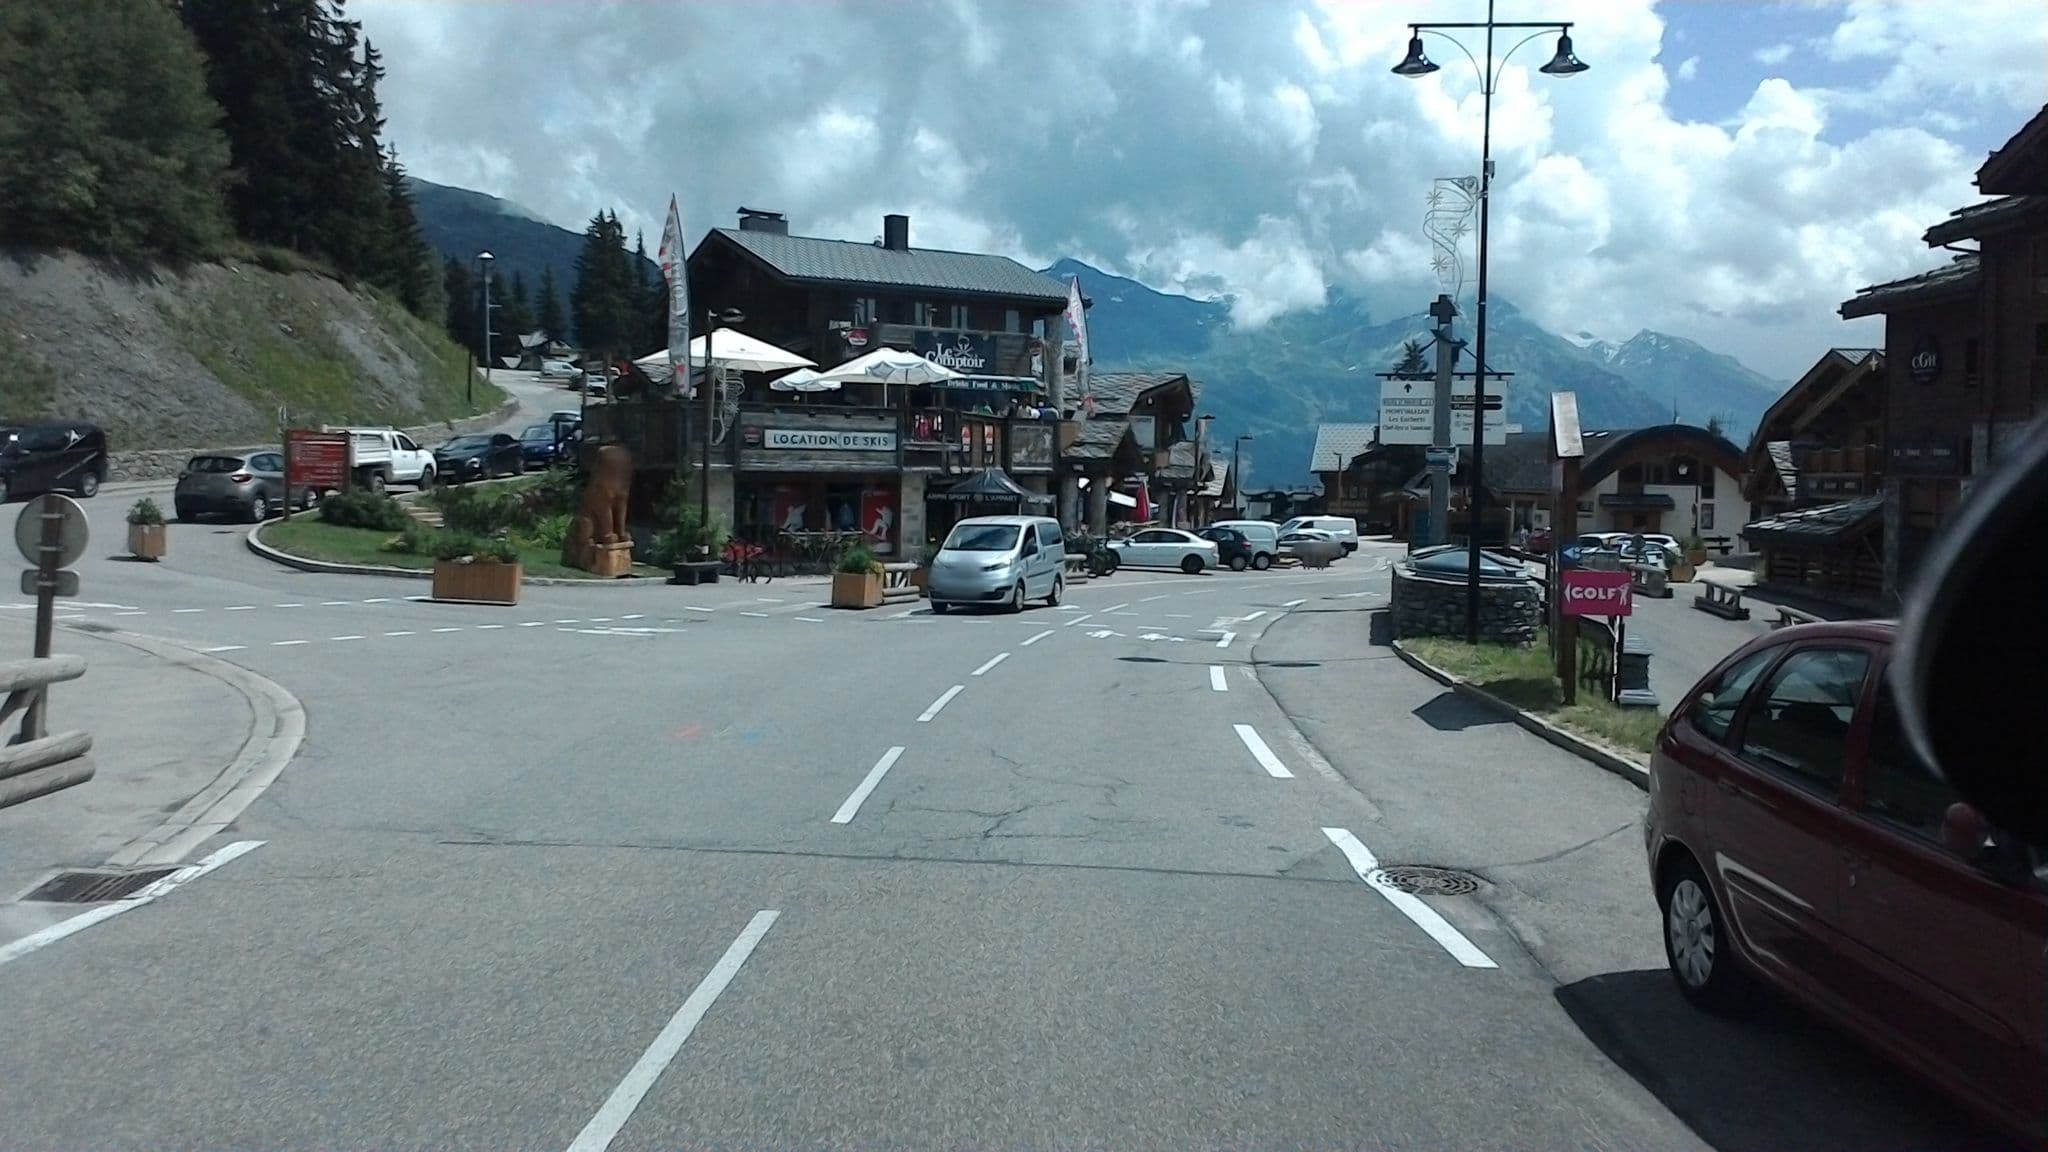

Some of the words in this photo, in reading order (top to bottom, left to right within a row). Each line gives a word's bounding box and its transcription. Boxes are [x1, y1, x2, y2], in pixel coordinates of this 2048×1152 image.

[936, 343, 953, 357] Le
[925, 350, 986, 369] Comptoir
[1911, 351, 1937, 369] CGH
[773, 434, 838, 446] LOCATION
[843, 436, 858, 446] DE
[863, 436, 889, 447] SKIS
[1571, 586, 1617, 600] GOLF
